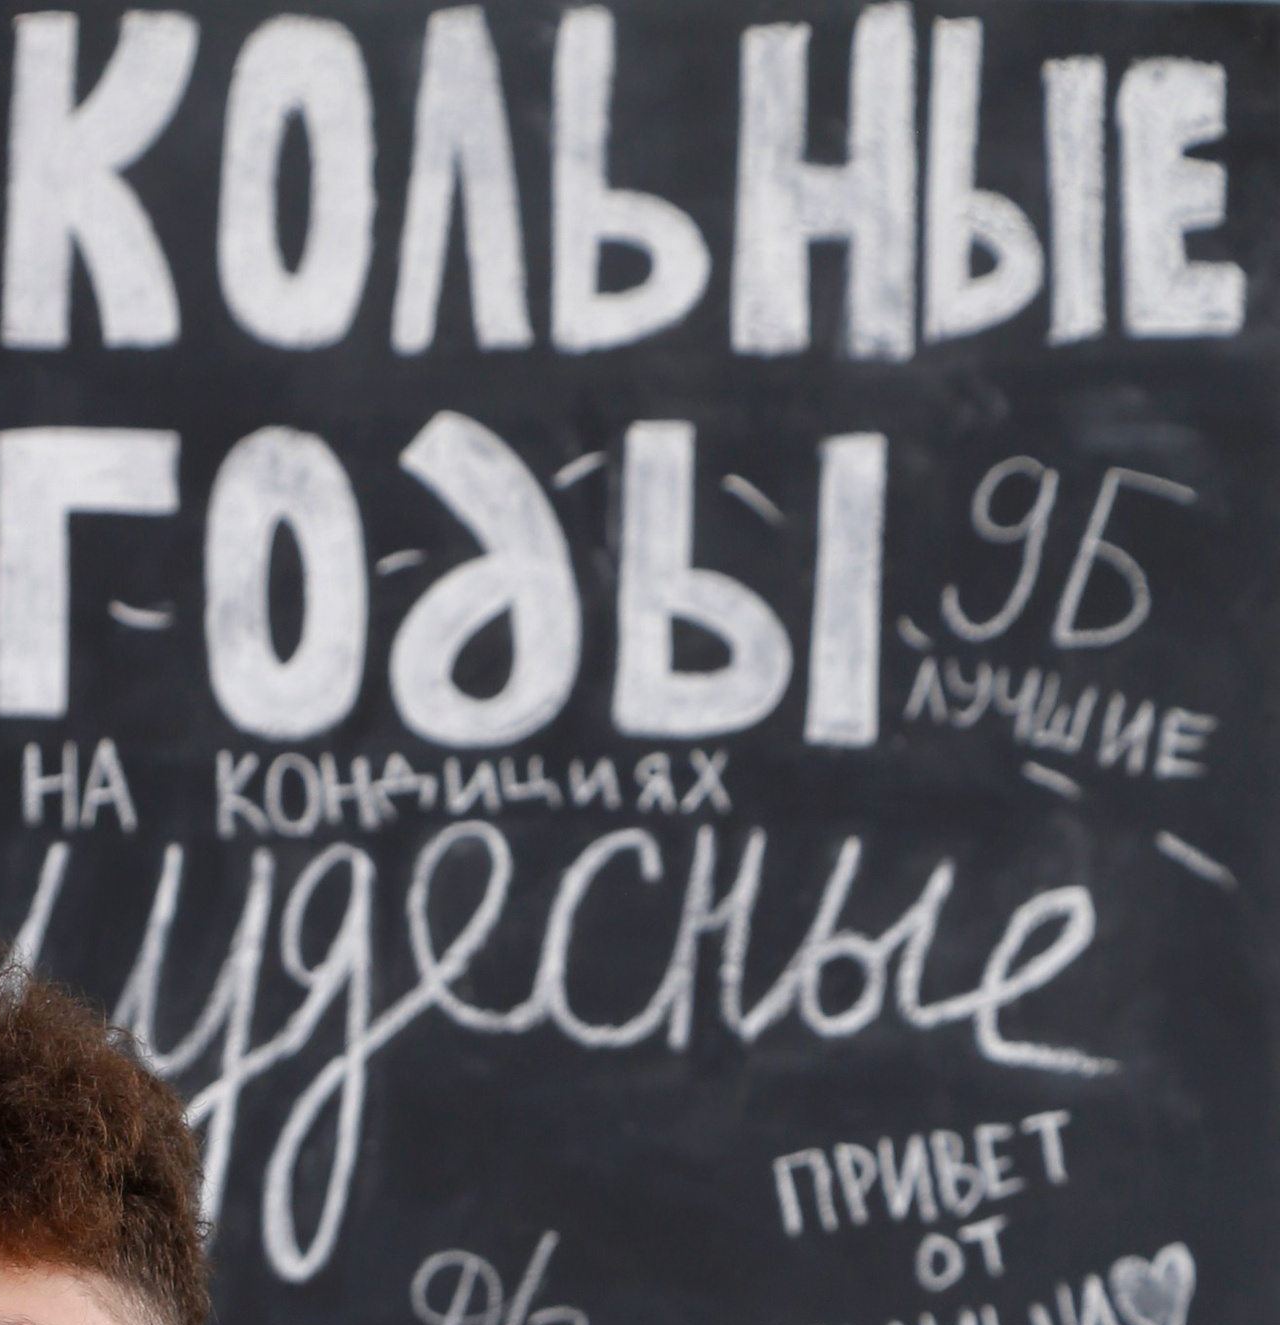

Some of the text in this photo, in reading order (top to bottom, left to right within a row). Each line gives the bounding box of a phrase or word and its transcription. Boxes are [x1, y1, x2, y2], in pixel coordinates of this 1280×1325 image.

[938, 453, 1198, 648] 9Б
[905, 656, 1222, 778] ЛУЧШИЕ
[22, 739, 732, 838] НА КОНДИЦИЯХ
[772, 1109, 1072, 1236] ПРИВЕТ
